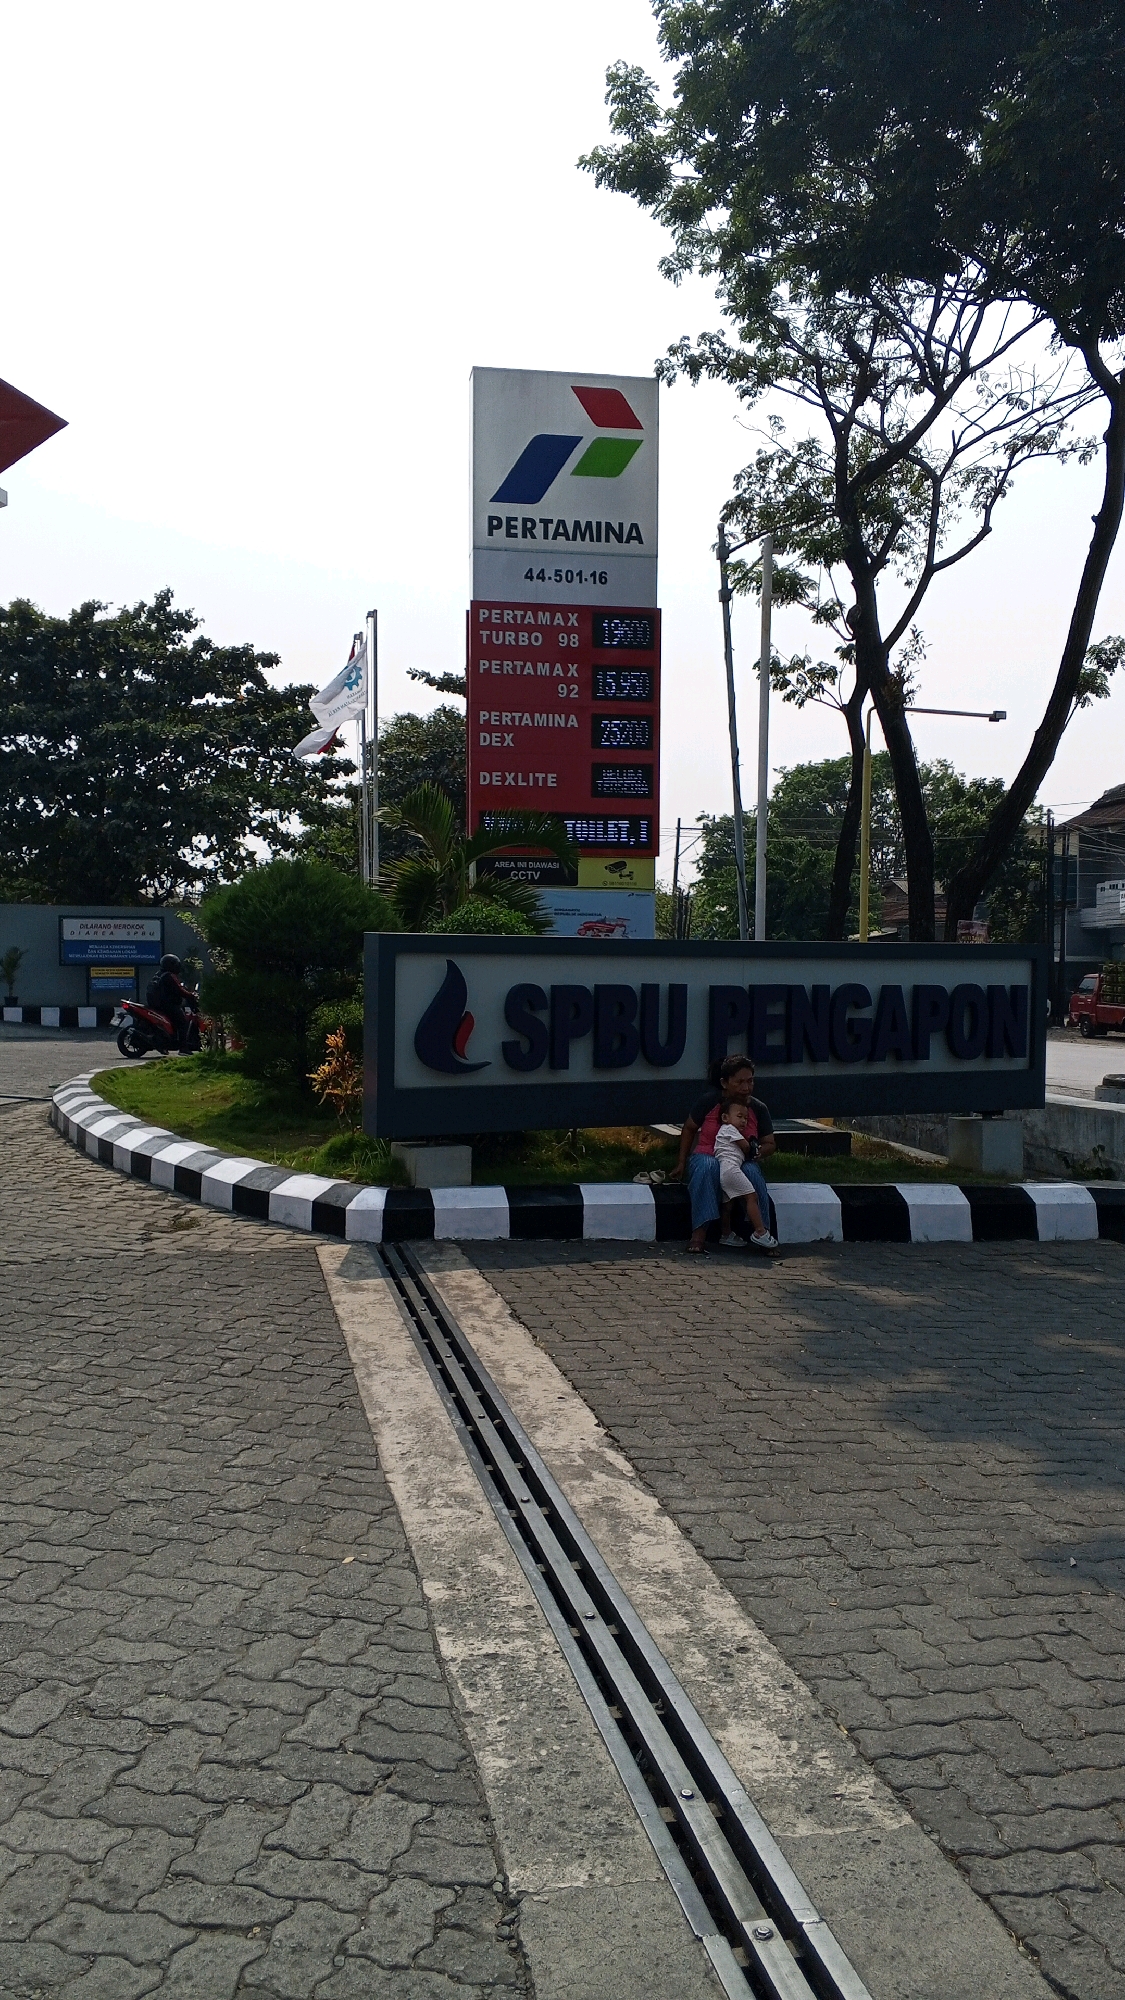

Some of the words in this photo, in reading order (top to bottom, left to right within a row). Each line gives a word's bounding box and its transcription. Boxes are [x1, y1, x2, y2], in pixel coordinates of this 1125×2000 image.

[487, 515, 644, 545] PERTAMINA
[479, 608, 579, 627] PERTAMAX
[479, 631, 543, 646] TURBO
[558, 633, 579, 648] 98
[479, 660, 579, 678] PERTAMAX
[557, 684, 579, 698] 92
[479, 710, 579, 728] PERTAMINA
[479, 733, 515, 747] DEX
[479, 771, 558, 787] DEXLITE
[494, 861, 515, 869] AREA
[517, 861, 527, 869] INI
[529, 861, 560, 869] DIAWASI
[510, 870, 541, 880] CCTV
[502, 983, 688, 1072] SPBU
[708, 983, 1028, 1065] PENGAPON
